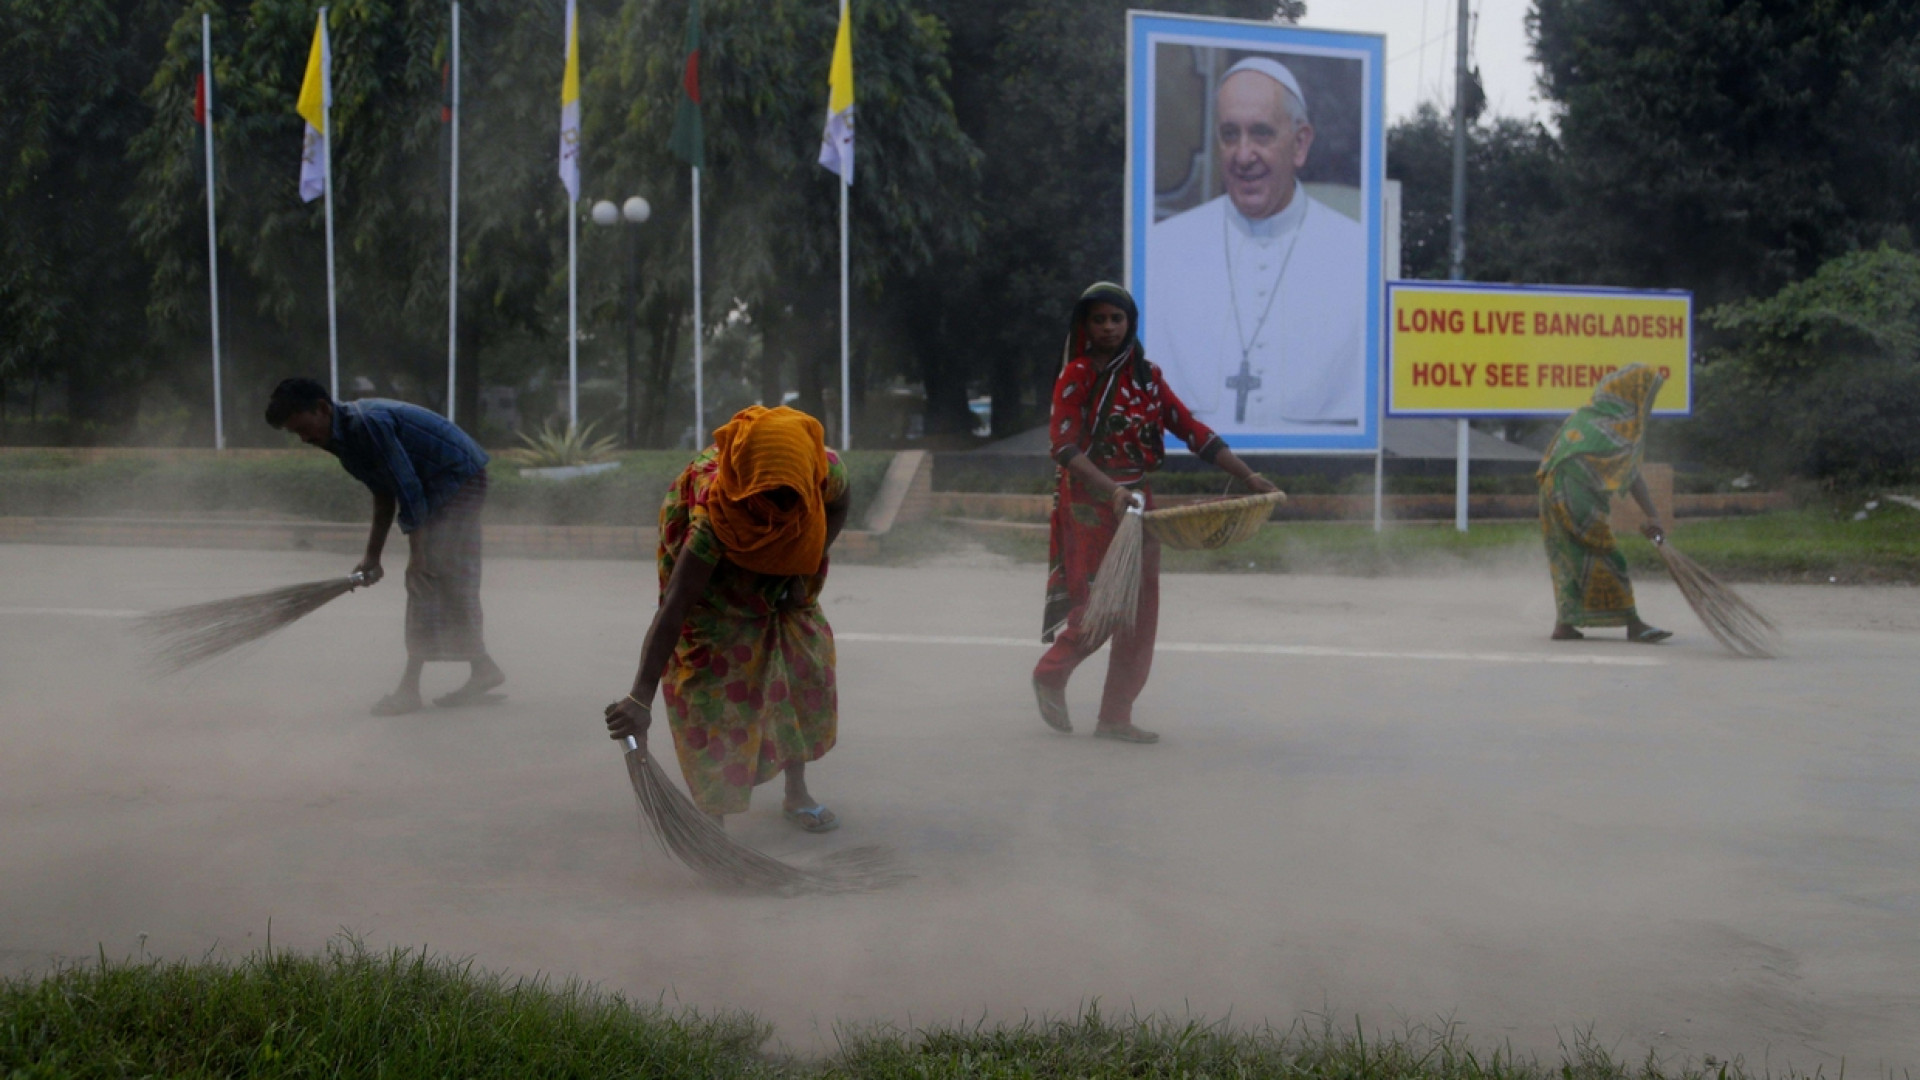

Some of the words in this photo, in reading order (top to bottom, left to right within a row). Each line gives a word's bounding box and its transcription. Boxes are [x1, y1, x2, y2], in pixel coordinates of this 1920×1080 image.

[1398, 308, 1464, 334] LONG
[1473, 311, 1525, 335] LIVE
[1533, 312, 1684, 339] BANGLADESH
[1412, 363, 1477, 387] HOLY
[1485, 364, 1529, 387] SEE
[1537, 364, 1670, 389] FRIENP
